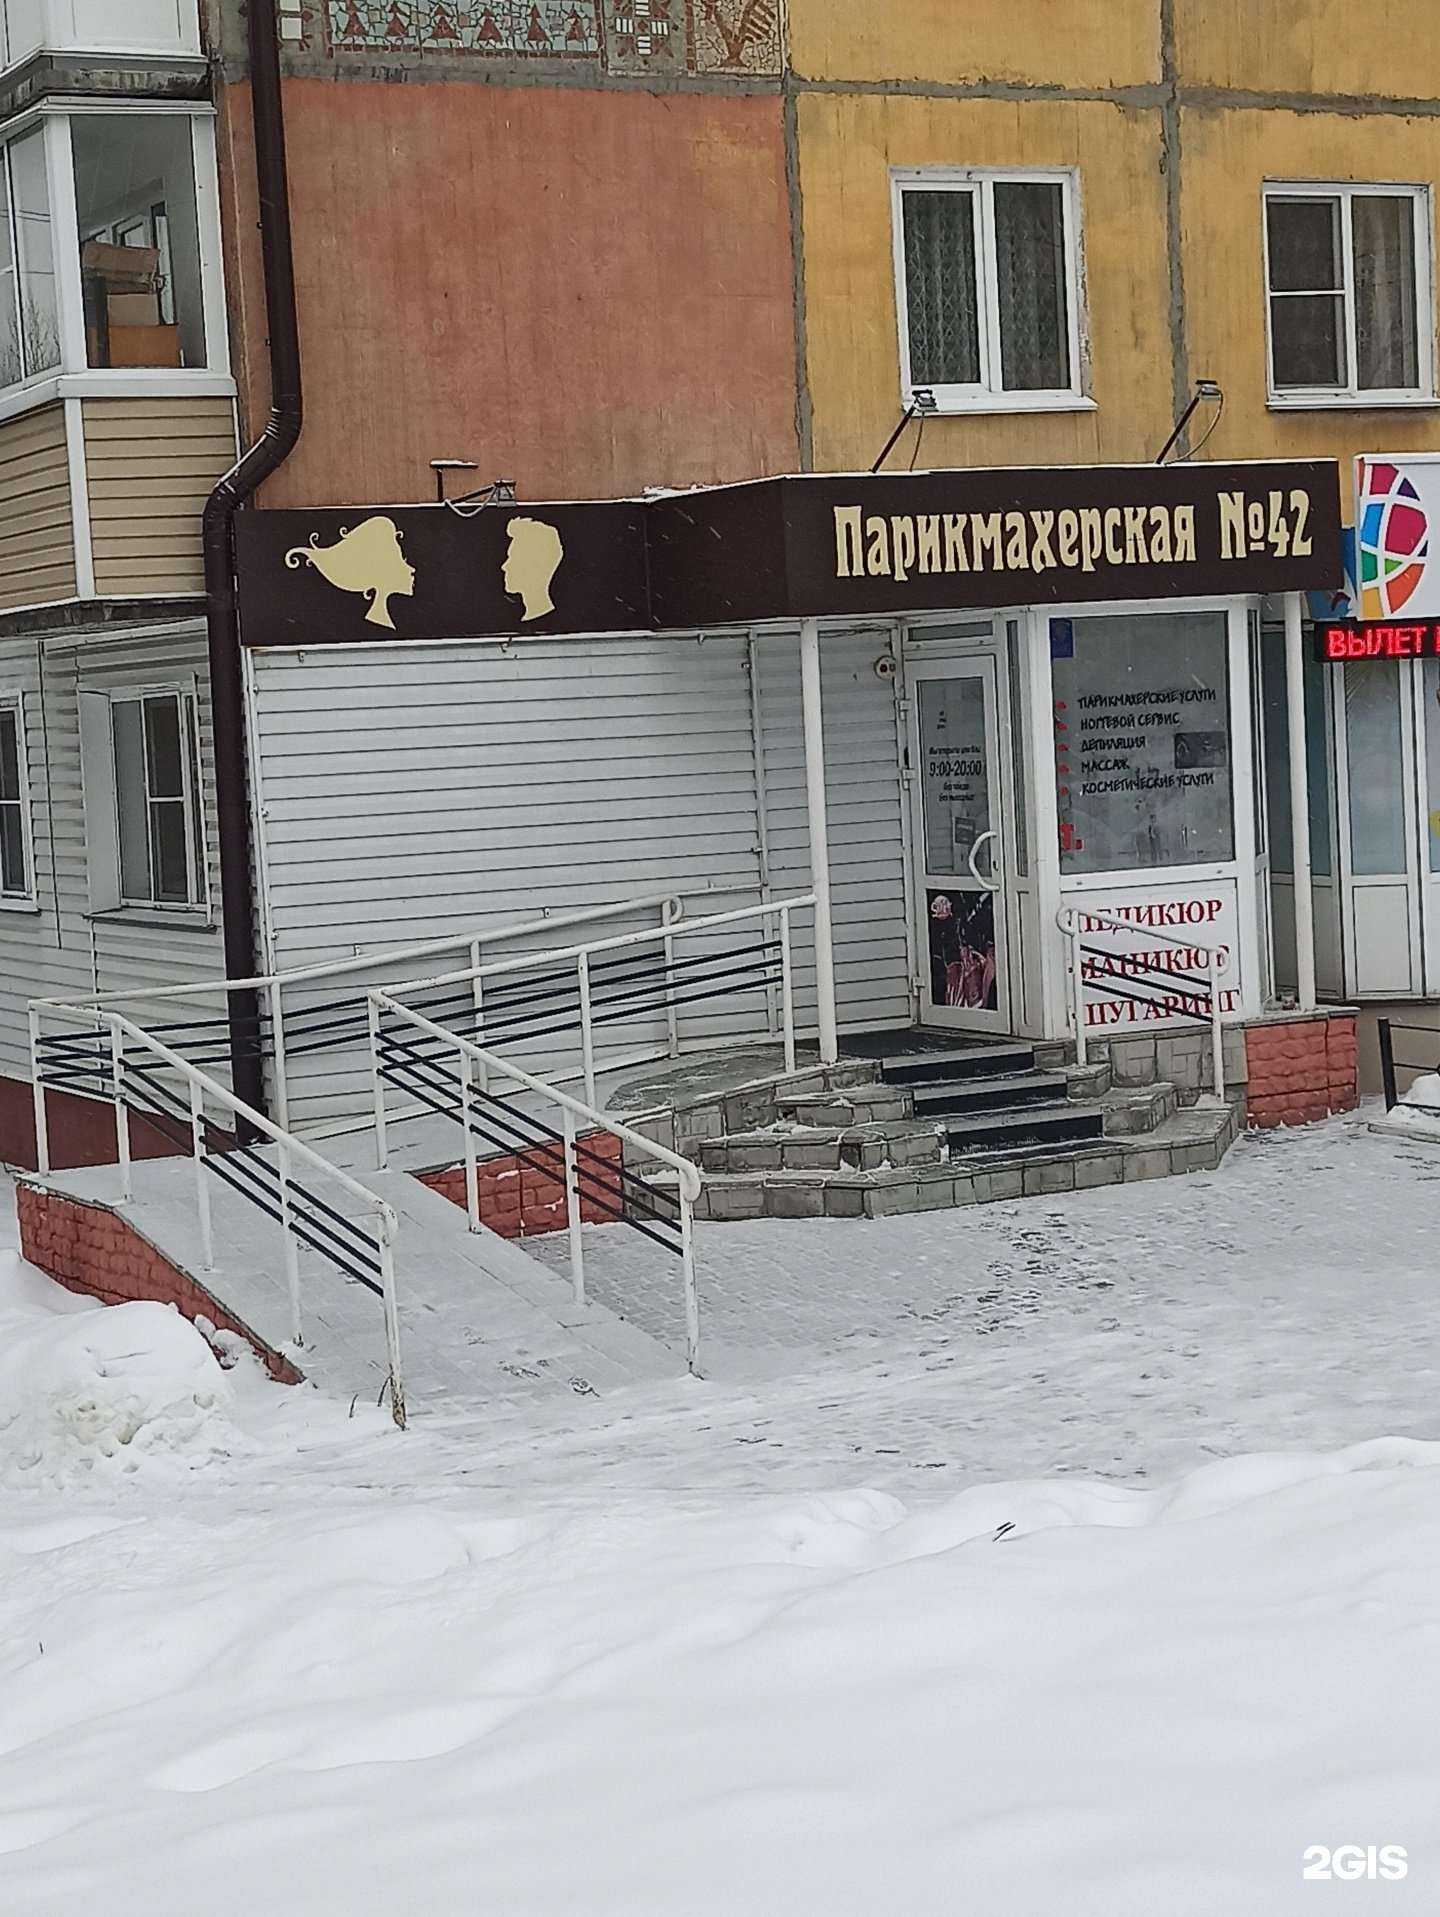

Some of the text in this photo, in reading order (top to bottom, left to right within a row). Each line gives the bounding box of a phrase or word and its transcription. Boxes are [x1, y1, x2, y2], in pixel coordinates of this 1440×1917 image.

[833, 488, 1314, 581] Парикмахерская №42
[1327, 626, 1428, 658] ВЫЛЕТ
[1078, 689, 1177, 710] ПАРИКМАХЕРСКИЕ
[1080, 712, 1181, 731] НОГТЕВОЙ СЕРВИС
[1080, 735, 1147, 753] ДЕПИЛЯЦИЯ
[929, 759, 983, 777] 9:00-20:00
[1081, 758, 1131, 774] МАССАЖ
[1081, 774, 1175, 796] КОСМЕТИЧЕСКИЕ
